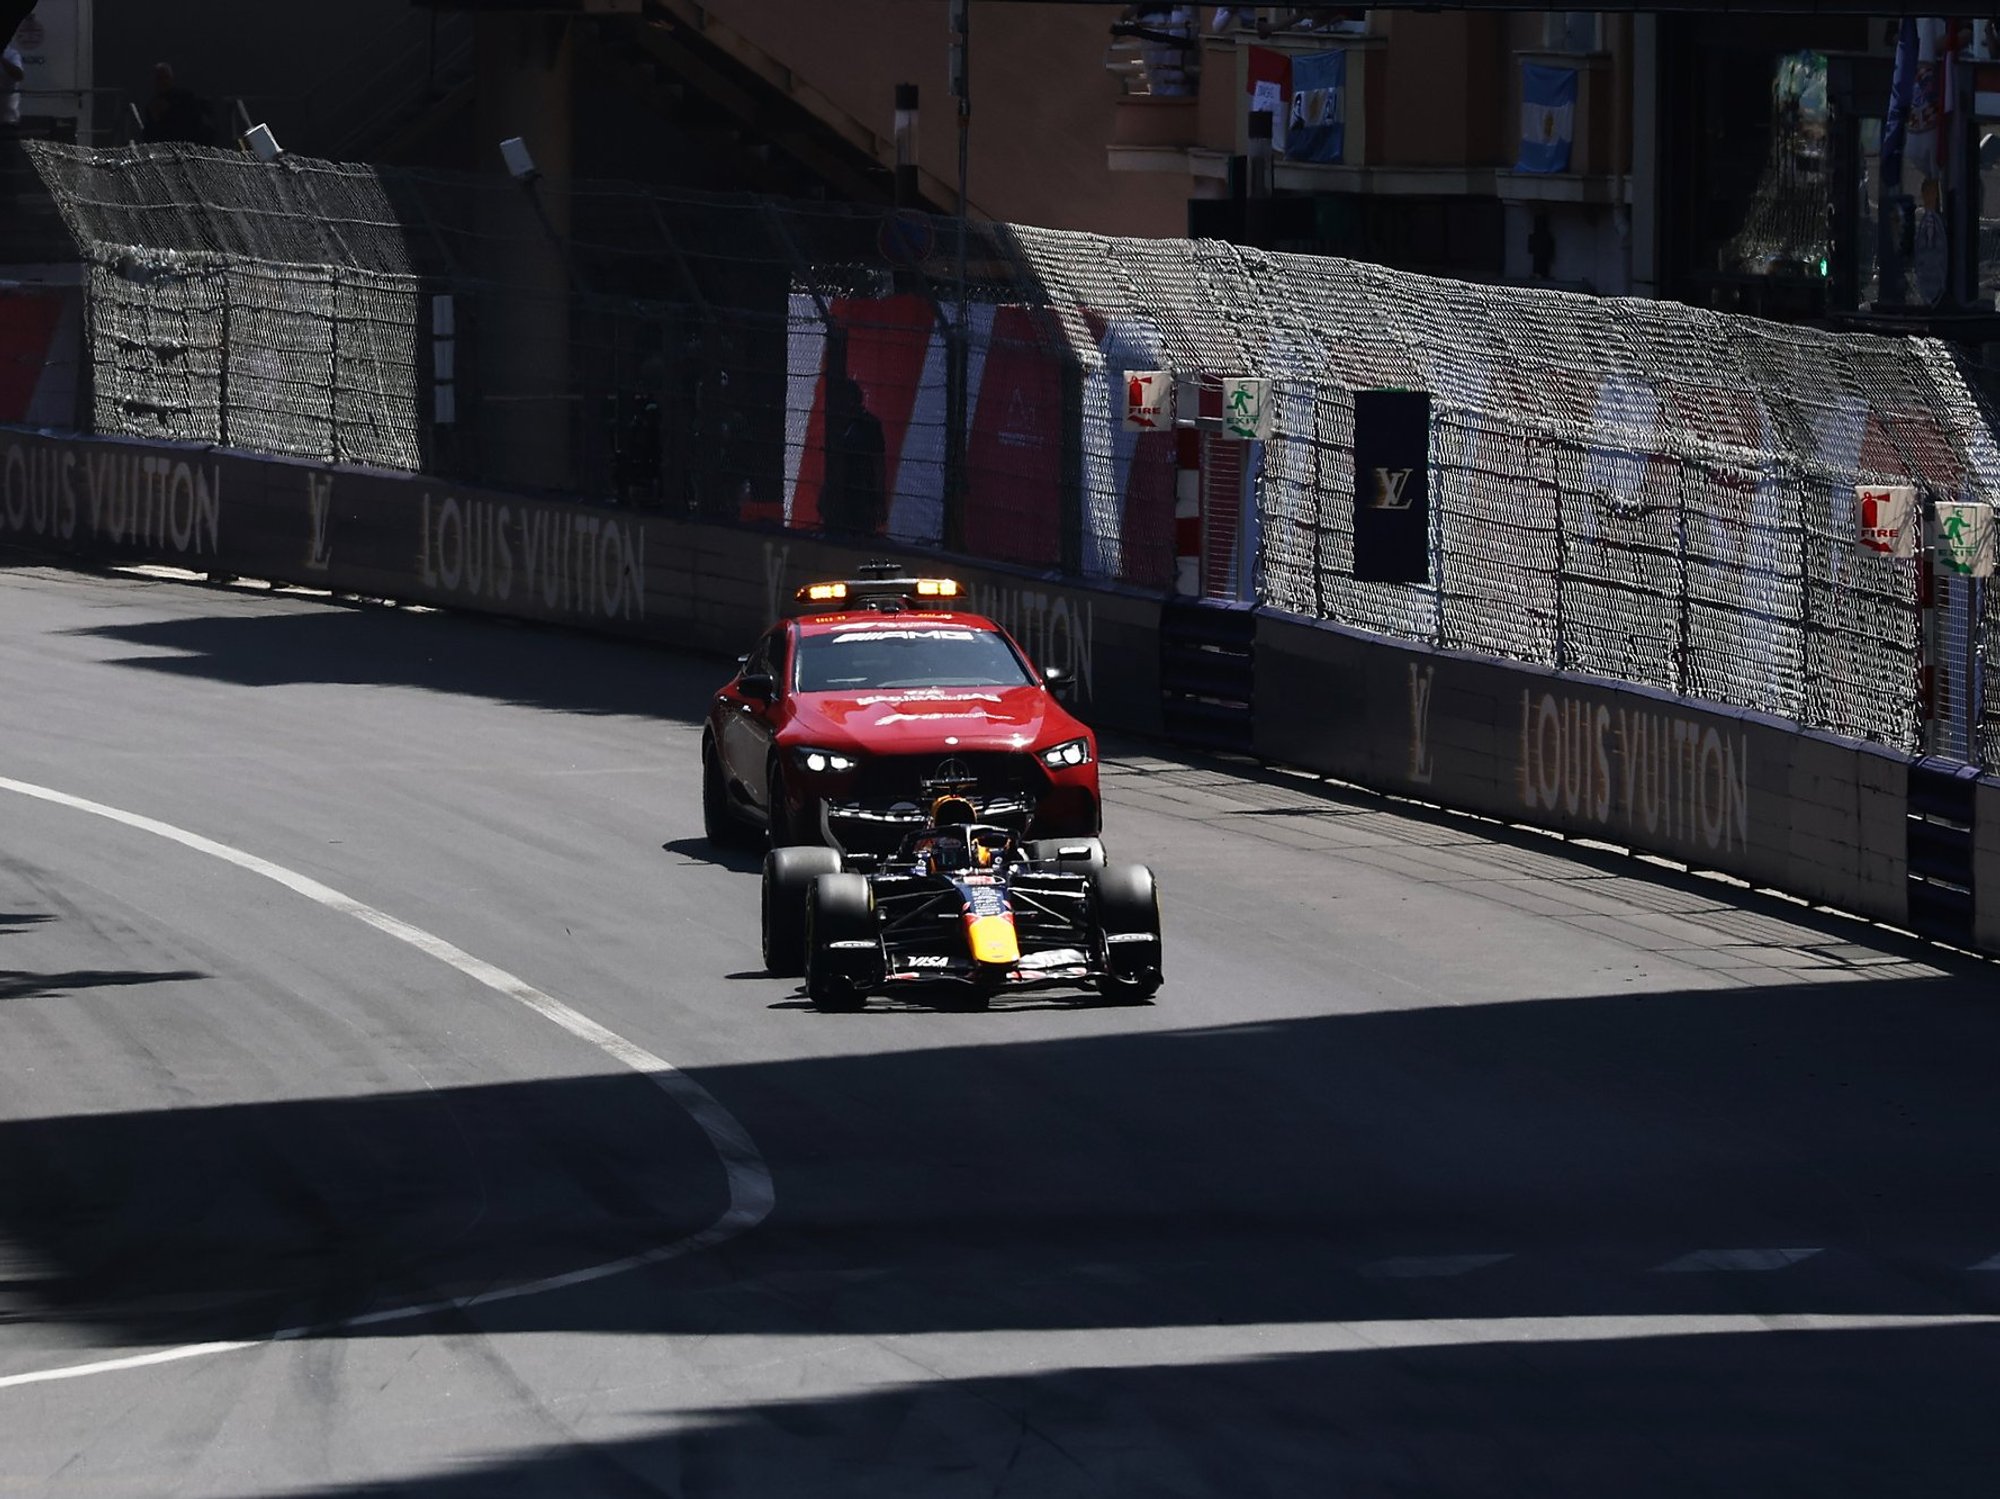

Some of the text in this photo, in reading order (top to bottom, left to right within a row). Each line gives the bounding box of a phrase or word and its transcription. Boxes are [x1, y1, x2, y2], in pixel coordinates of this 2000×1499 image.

[1128, 407, 1161, 415] FIRE
[1226, 417, 1258, 425] EXIT
[0, 443, 219, 555] OUIS VUITTON
[1861, 529, 1899, 538] FIRE
[422, 492, 645, 622] LOUIS VUITTON
[1938, 548, 1978, 557] EXIT
[1521, 688, 1748, 857] LOUIS VUITTON
[907, 956, 949, 968] VISA
